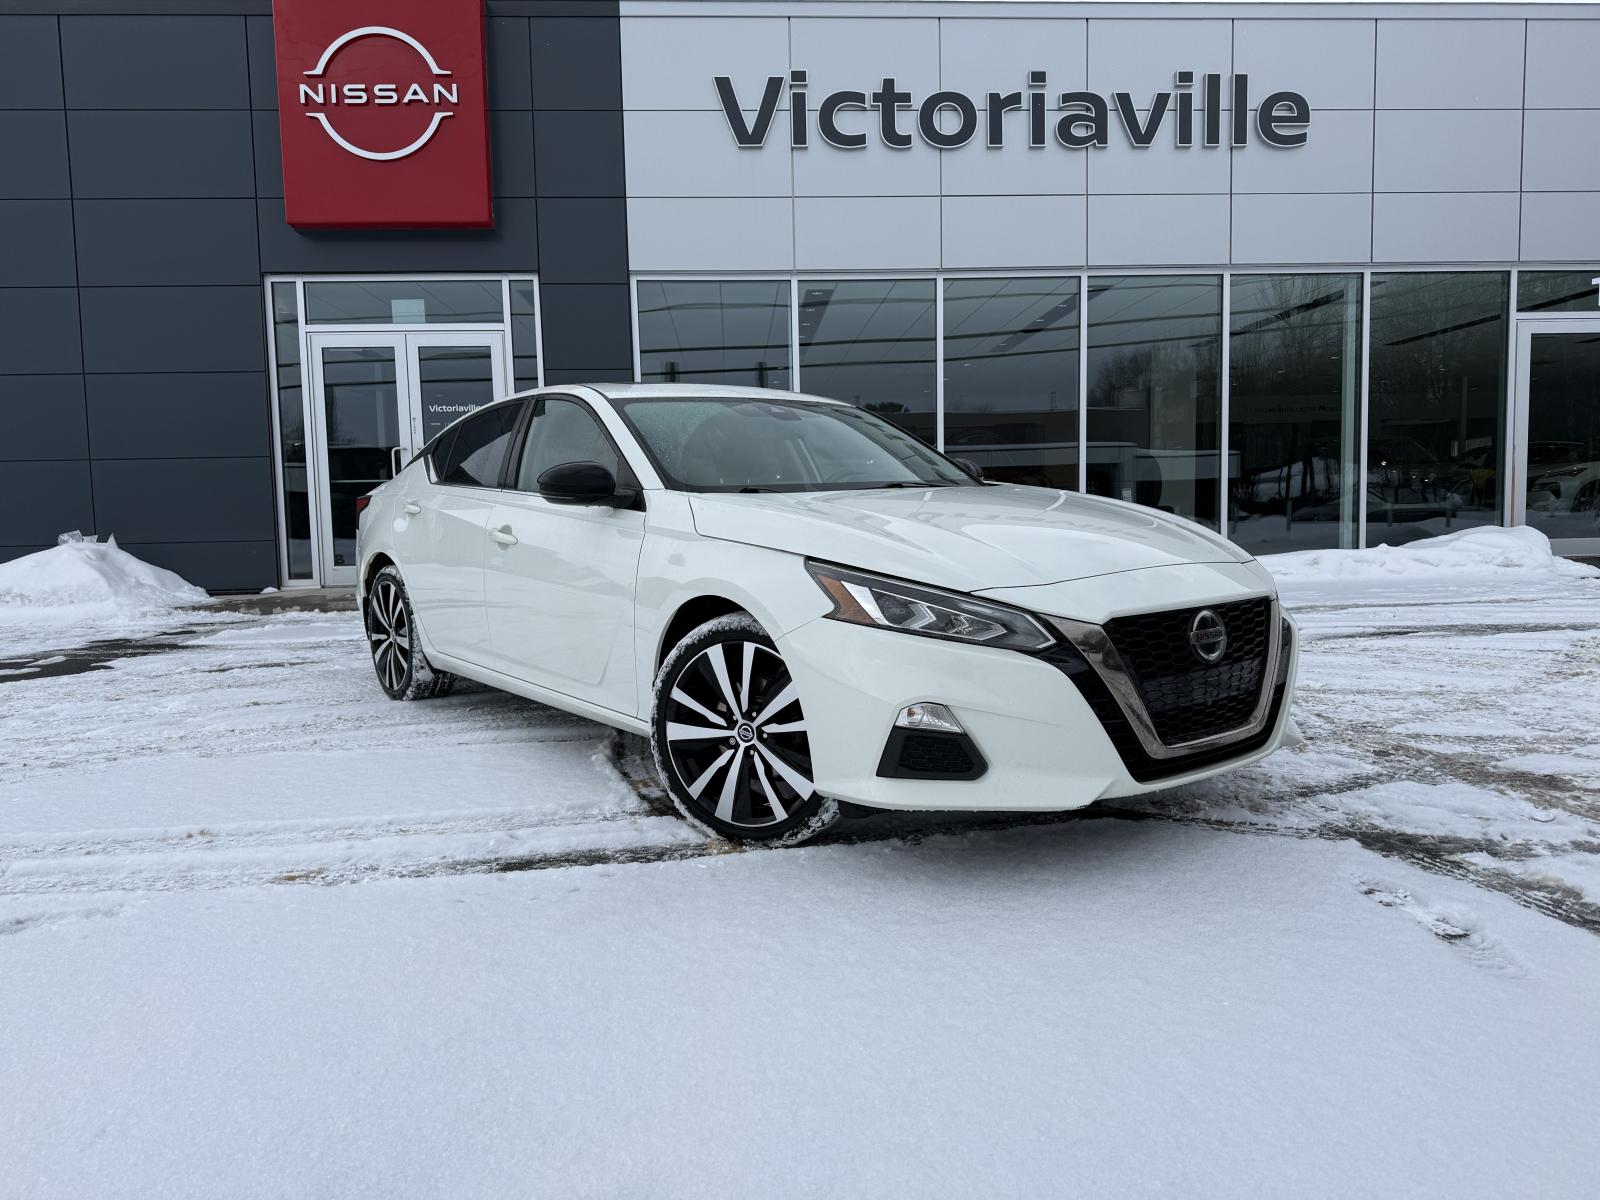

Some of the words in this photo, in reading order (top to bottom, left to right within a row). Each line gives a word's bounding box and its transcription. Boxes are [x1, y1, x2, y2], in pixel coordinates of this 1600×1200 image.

[299, 83, 458, 104] NISSAN
[712, 69, 1312, 150] Victoriaville
[1194, 629, 1223, 641] NISSAN
